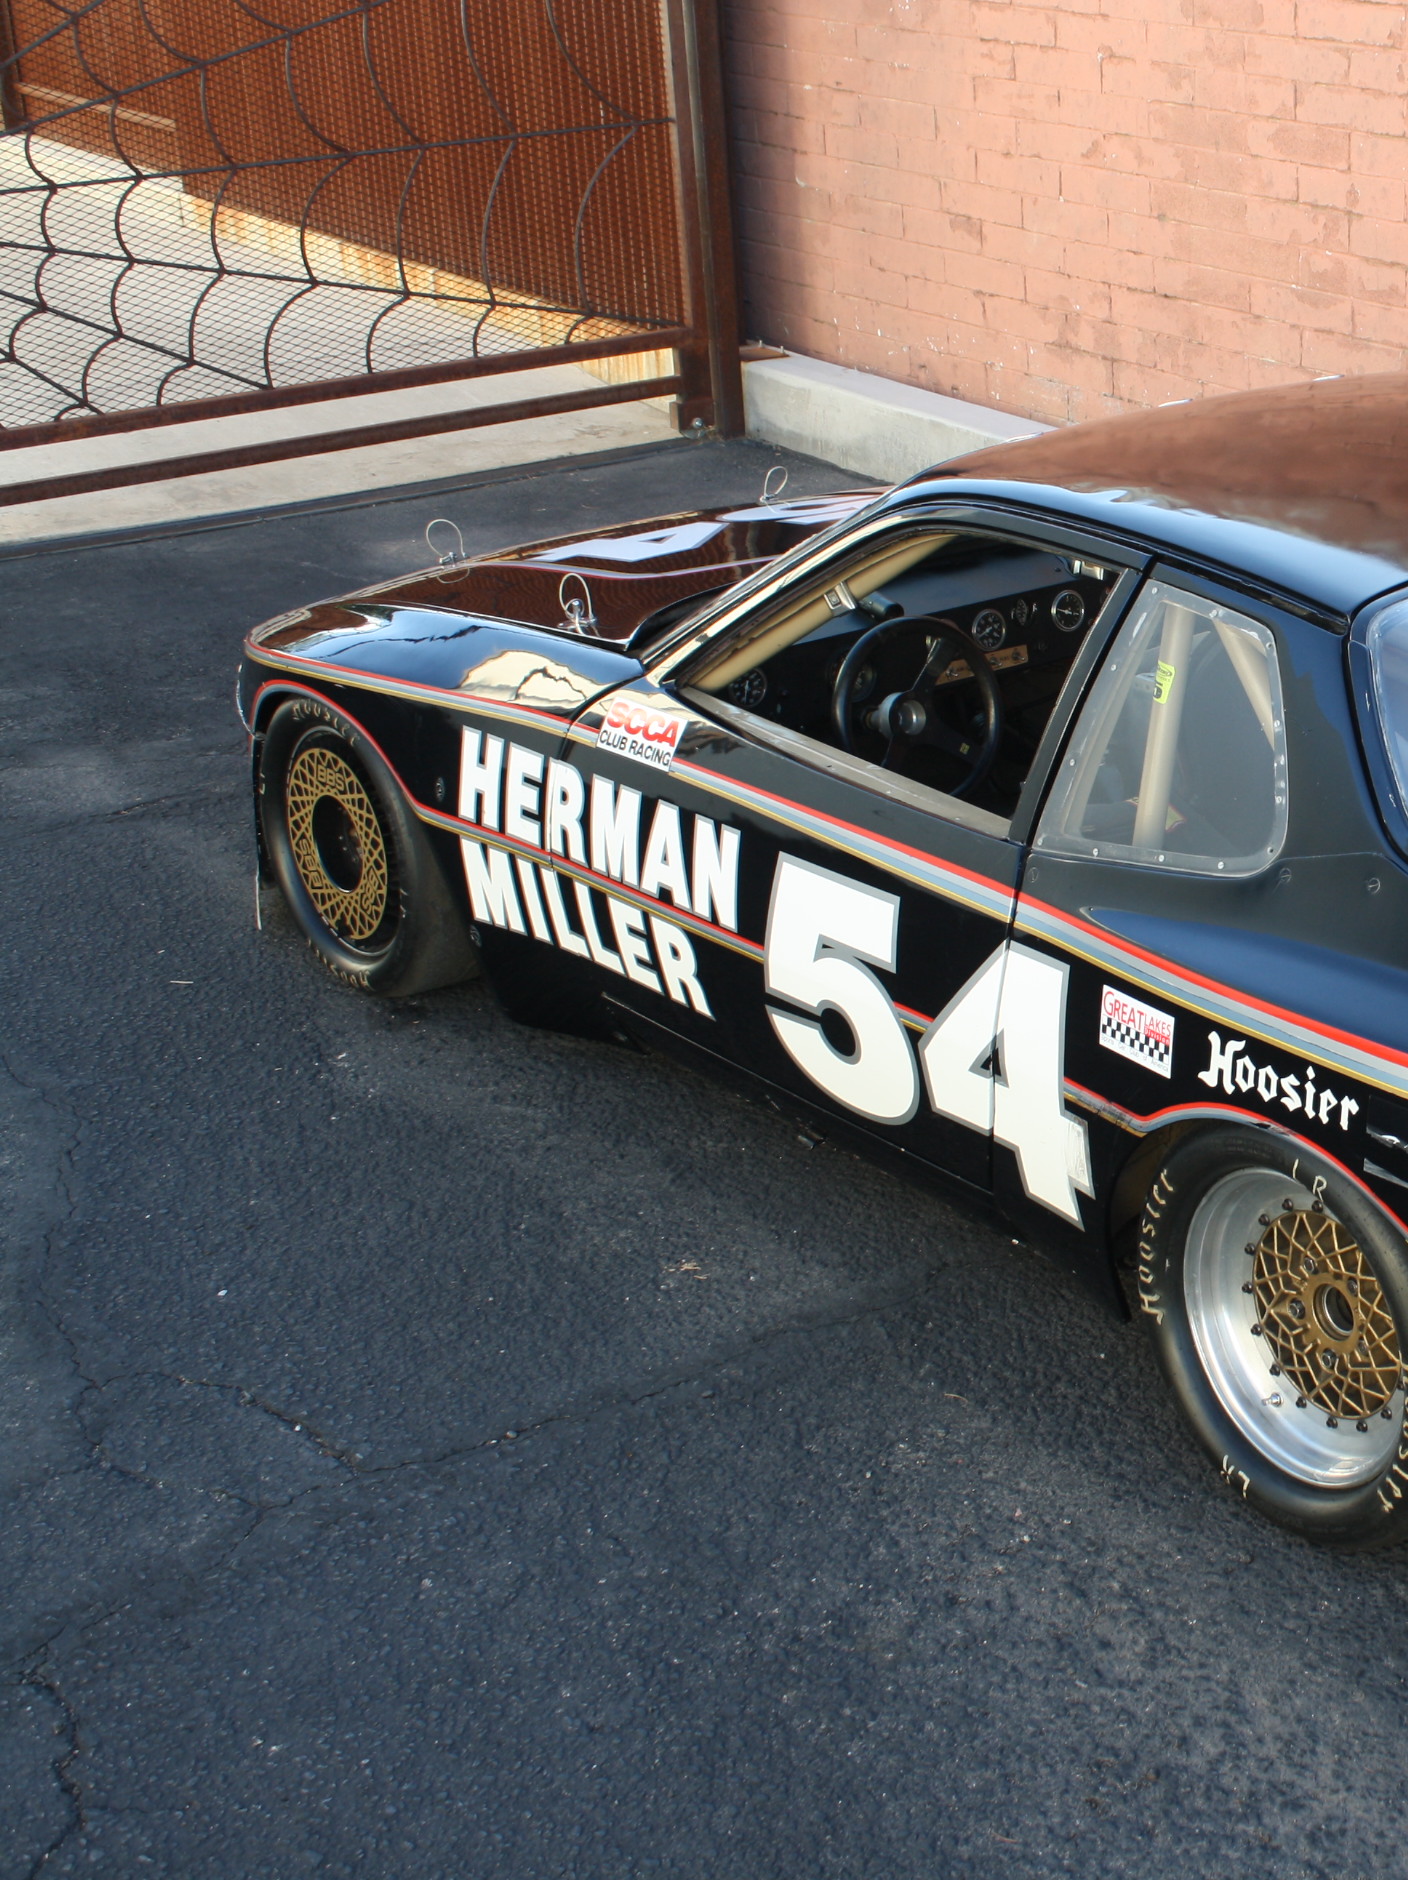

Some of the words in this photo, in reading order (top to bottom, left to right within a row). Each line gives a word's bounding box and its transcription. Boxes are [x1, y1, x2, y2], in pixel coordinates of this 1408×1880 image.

[599, 729, 628, 751] CLUB
[628, 739, 672, 767] RACING
[606, 701, 680, 748] SCCA
[317, 764, 346, 793] BBS
[458, 724, 742, 934] HERMAN
[458, 834, 718, 1022] MILLER
[763, 850, 1096, 1233] 54
[1103, 990, 1145, 1032] GREAT
[1144, 1013, 1172, 1038] LAKES
[1198, 1030, 1360, 1131] Hoosier
